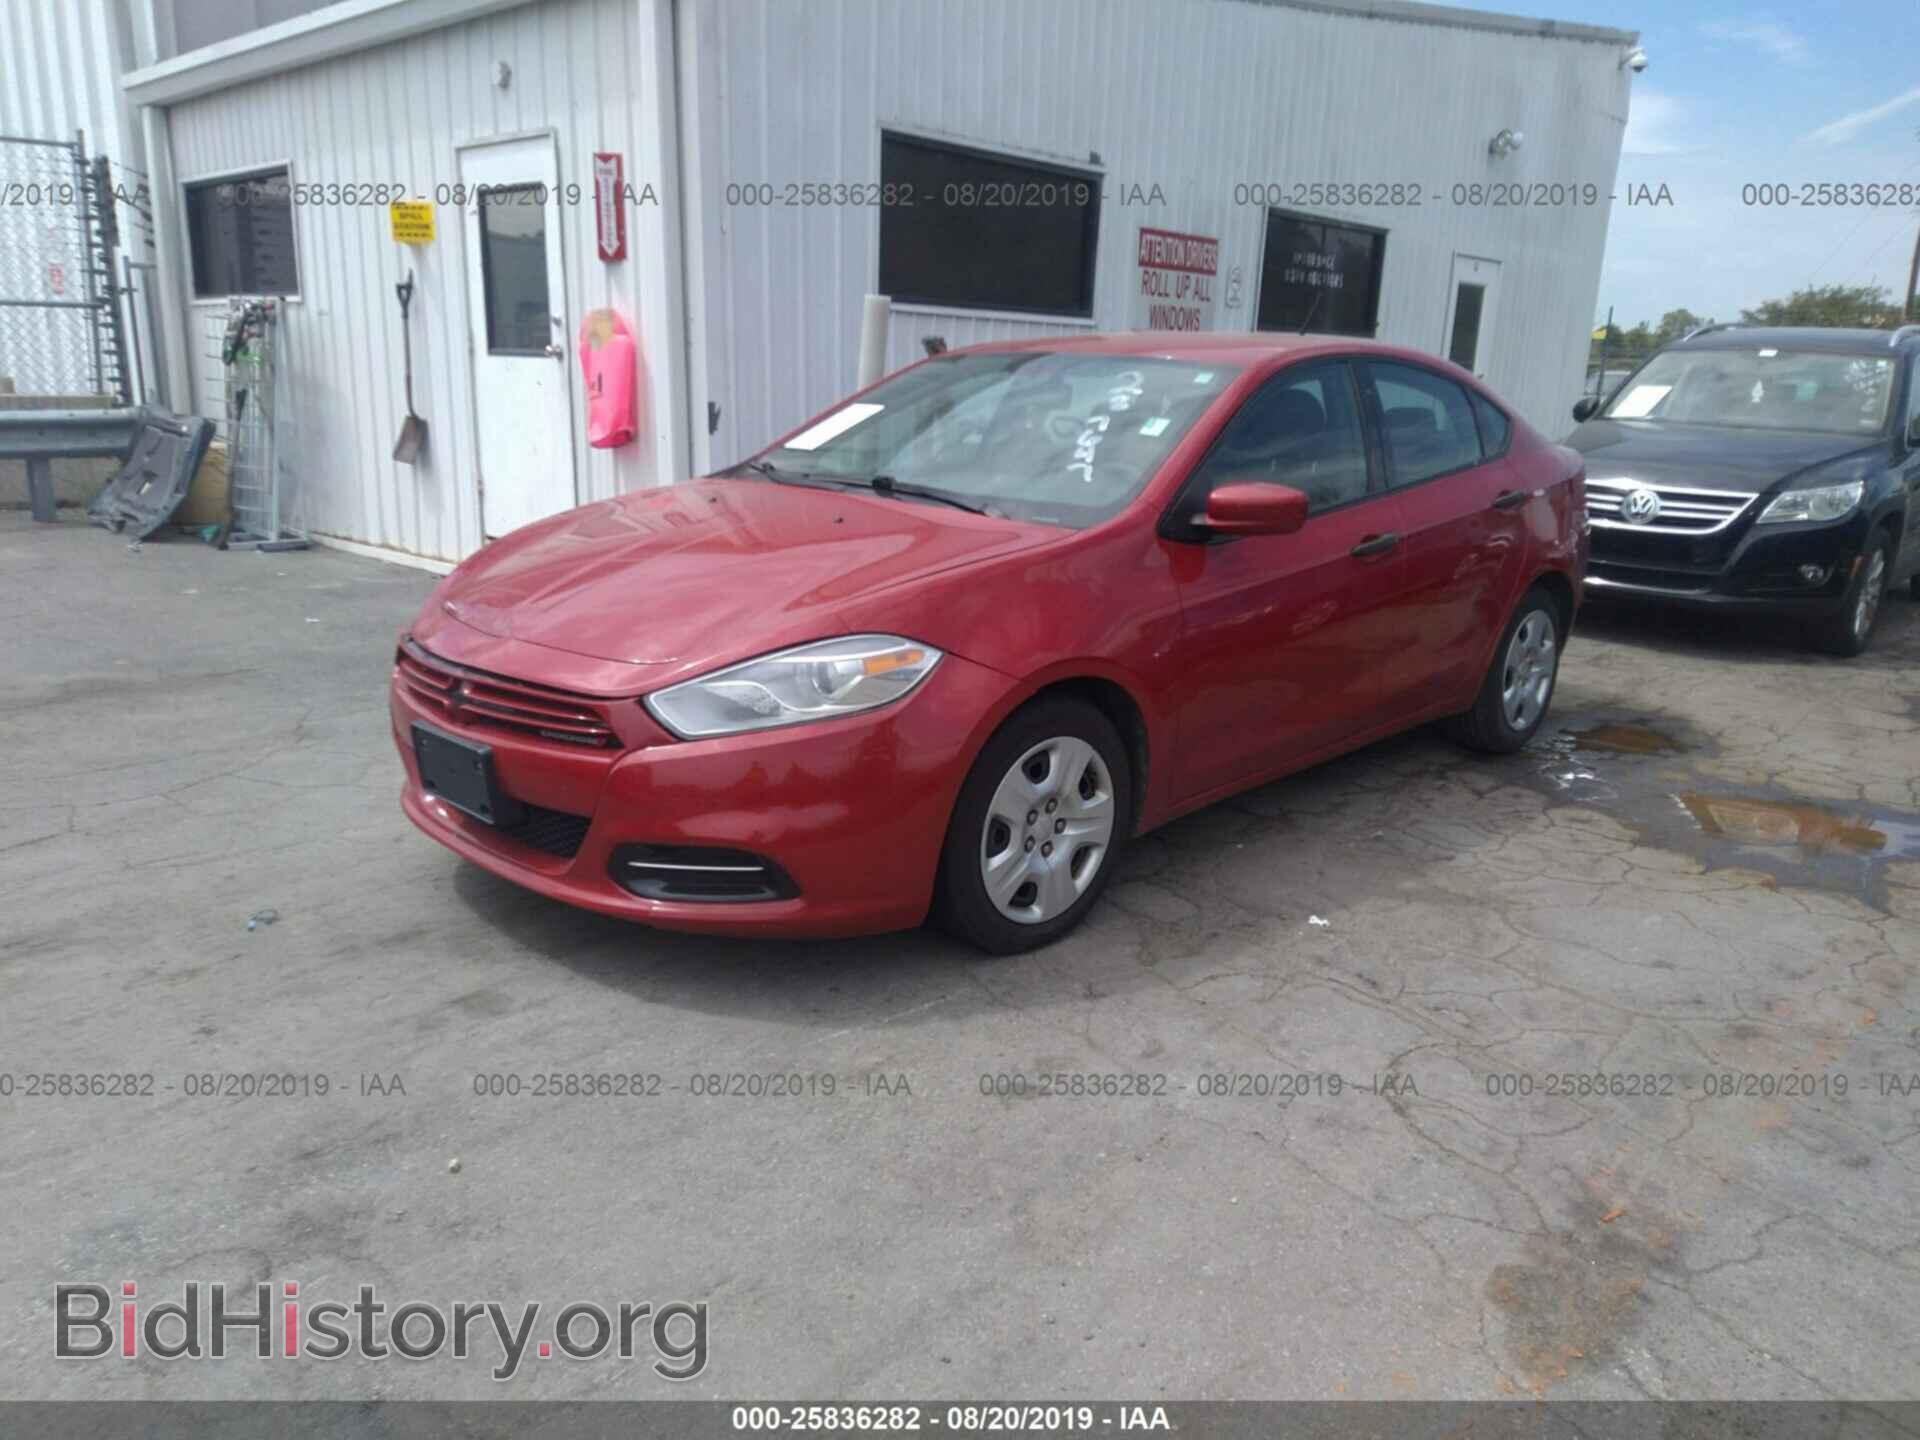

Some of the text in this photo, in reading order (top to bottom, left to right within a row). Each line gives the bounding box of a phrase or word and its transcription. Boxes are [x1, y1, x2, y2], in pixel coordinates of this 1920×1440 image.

[1141, 233, 1217, 272] ATTENTION DRIVERS
[1141, 269, 1170, 298] ROLL
[1176, 273, 1191, 299] UP
[1192, 276, 1211, 303] ALL
[1150, 303, 1201, 332] WINDOWS
